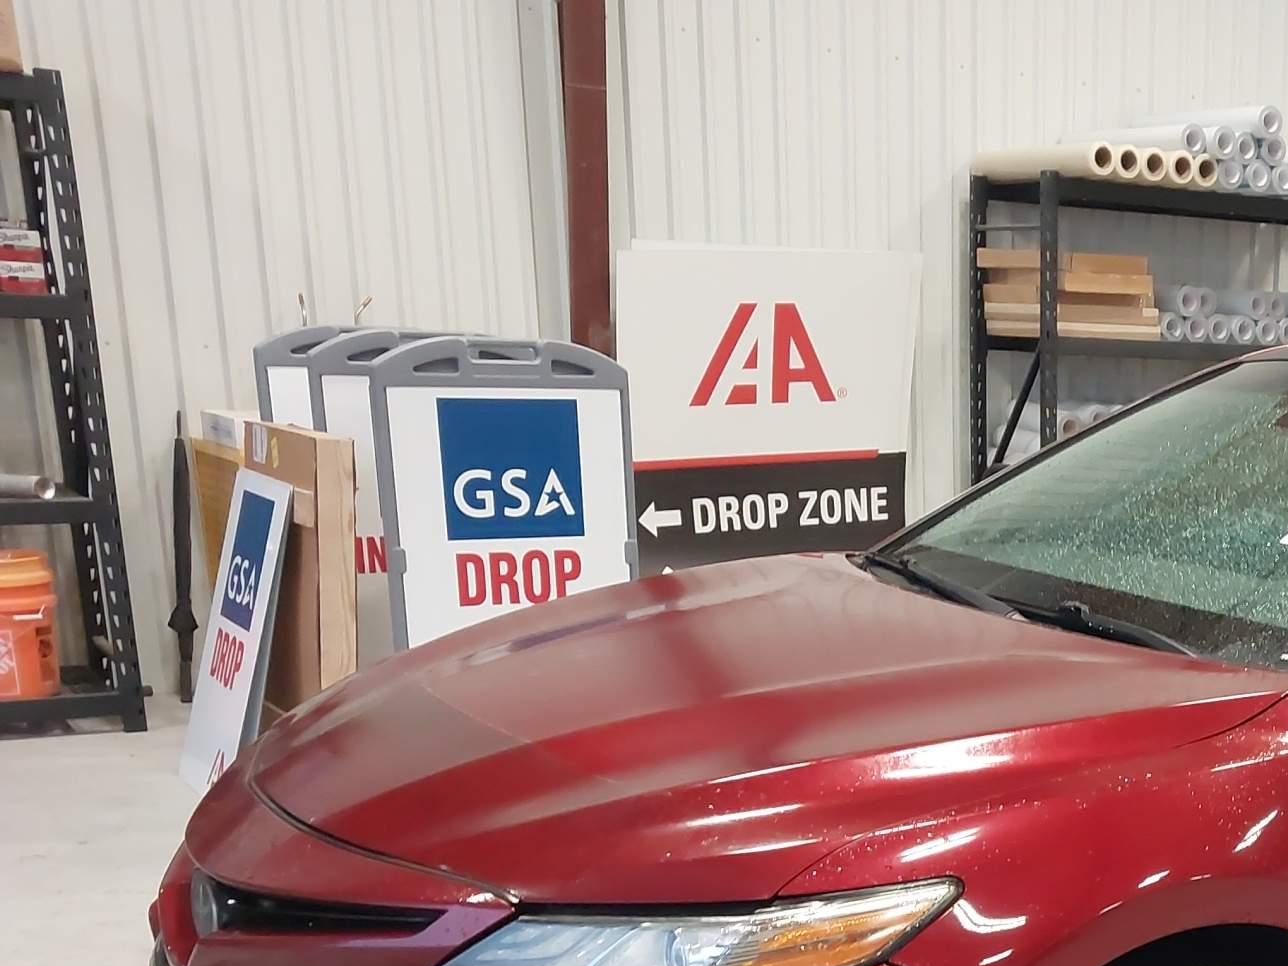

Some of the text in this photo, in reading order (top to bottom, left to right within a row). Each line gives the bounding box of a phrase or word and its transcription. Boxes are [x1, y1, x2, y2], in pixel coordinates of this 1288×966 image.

[453, 468, 576, 518] GSA
[692, 486, 889, 534] DROP ZONE
[226, 555, 255, 611] GSA
[456, 549, 582, 607] DROP
[209, 627, 245, 690] DROP
